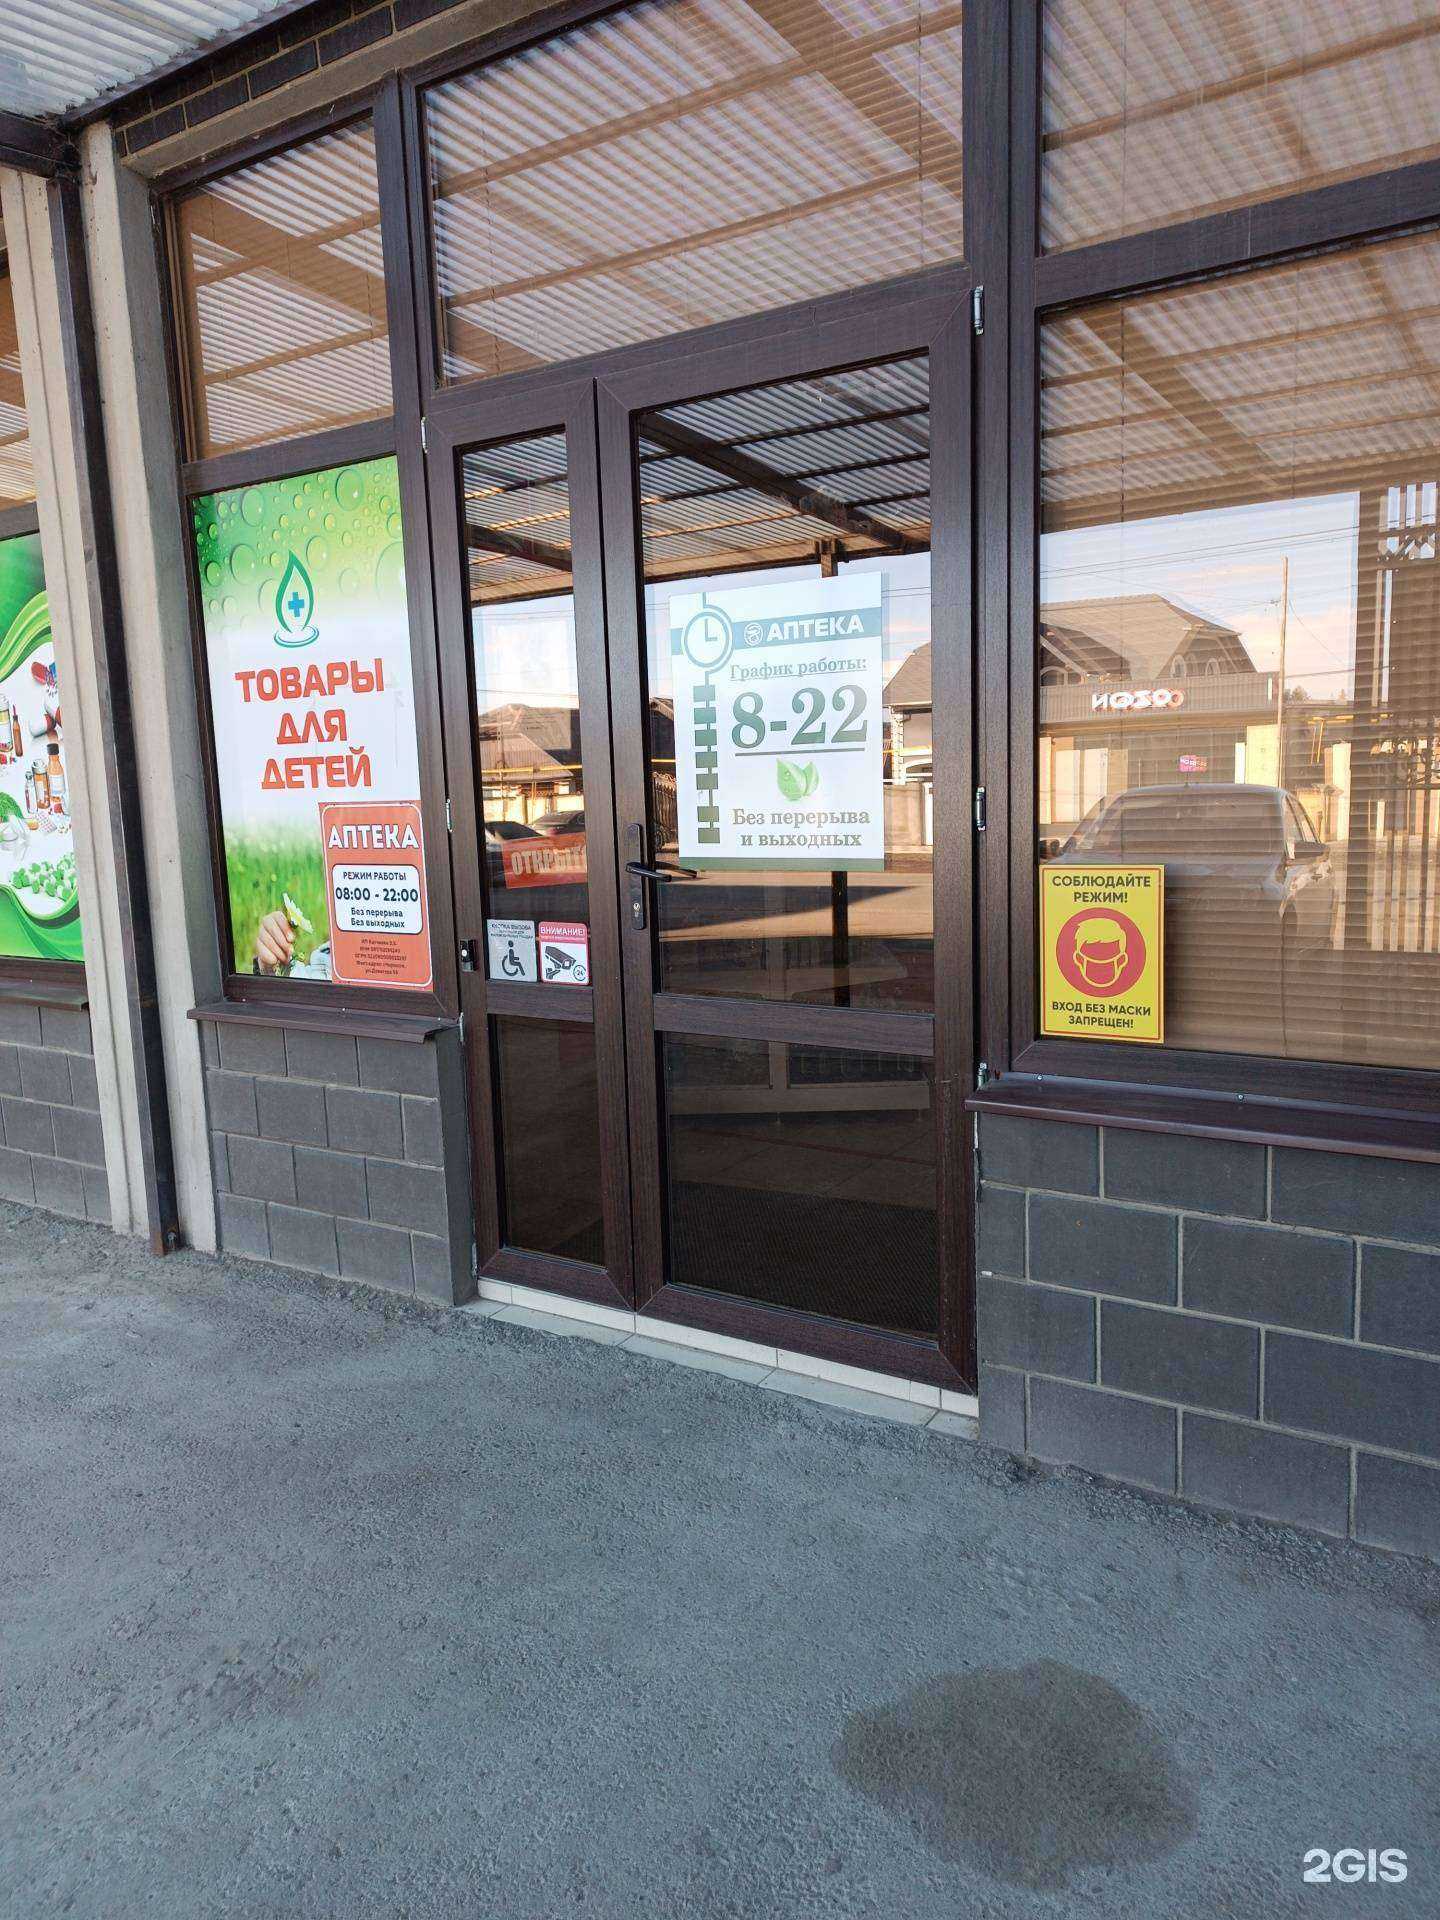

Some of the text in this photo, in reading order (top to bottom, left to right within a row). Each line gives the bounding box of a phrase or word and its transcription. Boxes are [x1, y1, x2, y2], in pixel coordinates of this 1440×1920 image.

[767, 614, 864, 642] АПТЕКА
[730, 657, 867, 680] График работы:
[235, 658, 384, 702] ТОВАРЫ
[731, 684, 867, 749] 8-22
[277, 709, 347, 744] ДЛЯ
[261, 746, 372, 789] ДЕТЕЙ
[732, 808, 870, 829] Без перерыва
[328, 823, 419, 849] АПТЕКА
[740, 831, 862, 849] и выходных
[343, 871, 407, 881] РЕЖИМ РАБОТЫ
[1052, 873, 1151, 889] СОБЛЮДАЙТЕ
[335, 887, 371, 901] 08:00
[383, 888, 419, 902] 22:00
[1074, 891, 1128, 903] РЕЖИМ!
[351, 907, 404, 918] Без перерыва
[351, 917, 405, 929] Без выходных
[1052, 1001, 1151, 1016] ВХОД БЕЗ МАСКИ
[1068, 1015, 1134, 1029] ЗАПРЕЩЕН!
